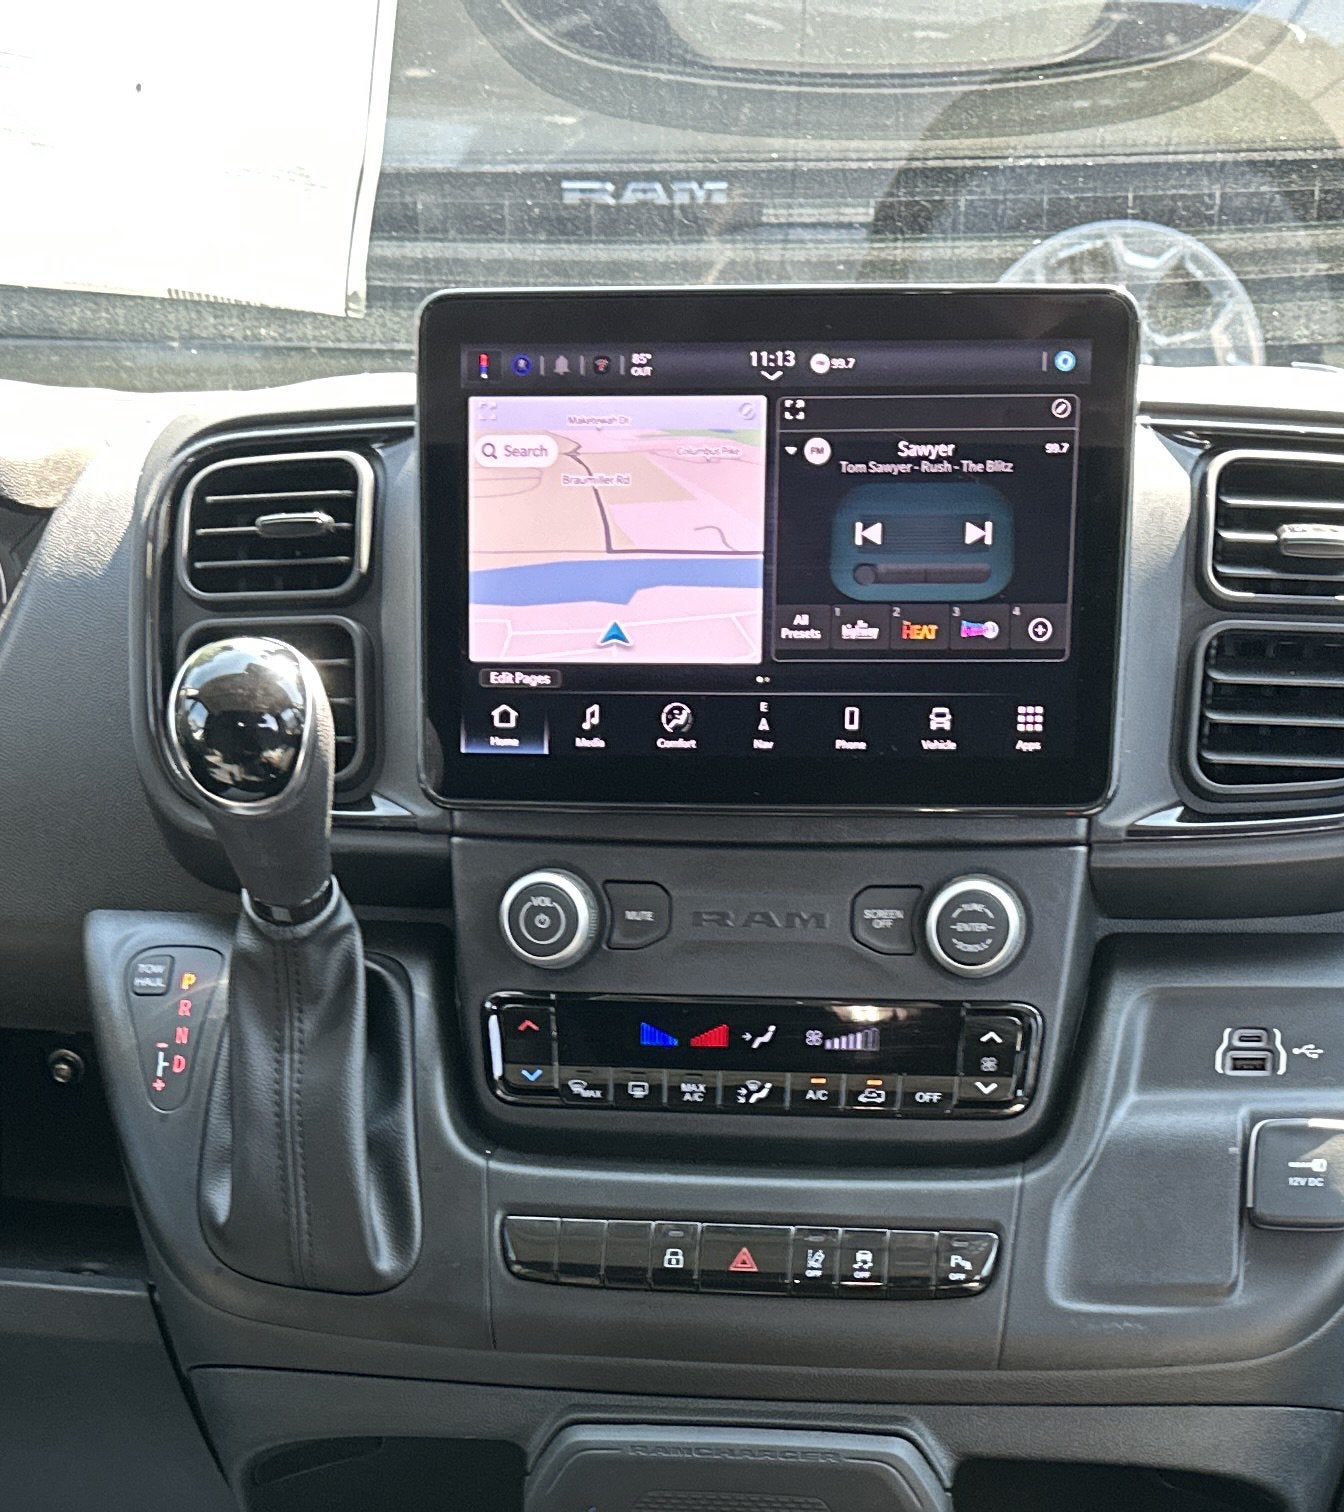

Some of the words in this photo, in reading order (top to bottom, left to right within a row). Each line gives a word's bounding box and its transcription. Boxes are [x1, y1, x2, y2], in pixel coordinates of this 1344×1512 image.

[561, 180, 728, 205] RAM
[750, 350, 796, 367] 11:13
[630, 366, 653, 376] OUT
[504, 445, 548, 457] Search
[897, 441, 955, 459] Sawyer
[840, 461, 868, 473] Tom
[869, 461, 912, 476] Sawyer
[921, 461, 952, 473] Rush
[961, 460, 984, 472] The
[985, 460, 1014, 472] Blitz
[793, 615, 810, 626] All
[781, 628, 821, 640] Presets
[902, 624, 939, 639] HEAT
[490, 672, 514, 685] Edit
[515, 672, 551, 687] Pages
[530, 896, 554, 907] VOL
[625, 910, 655, 921] MUTE
[692, 911, 829, 929] RAM
[863, 909, 904, 919] SCREEN
[871, 919, 894, 929] OFF
[180, 971, 197, 990] P
[177, 999, 192, 1016] R
[175, 1026, 189, 1044] N
[172, 1054, 186, 1073] D
[681, 1083, 705, 1092] MAX
[582, 1089, 602, 1099] MAX
[683, 1092, 704, 1102] A/C
[806, 1089, 828, 1101] A/C
[915, 1092, 942, 1103] OFF
[1288, 1177, 1307, 1186] 12V
[1308, 1177, 1325, 1187] DC
